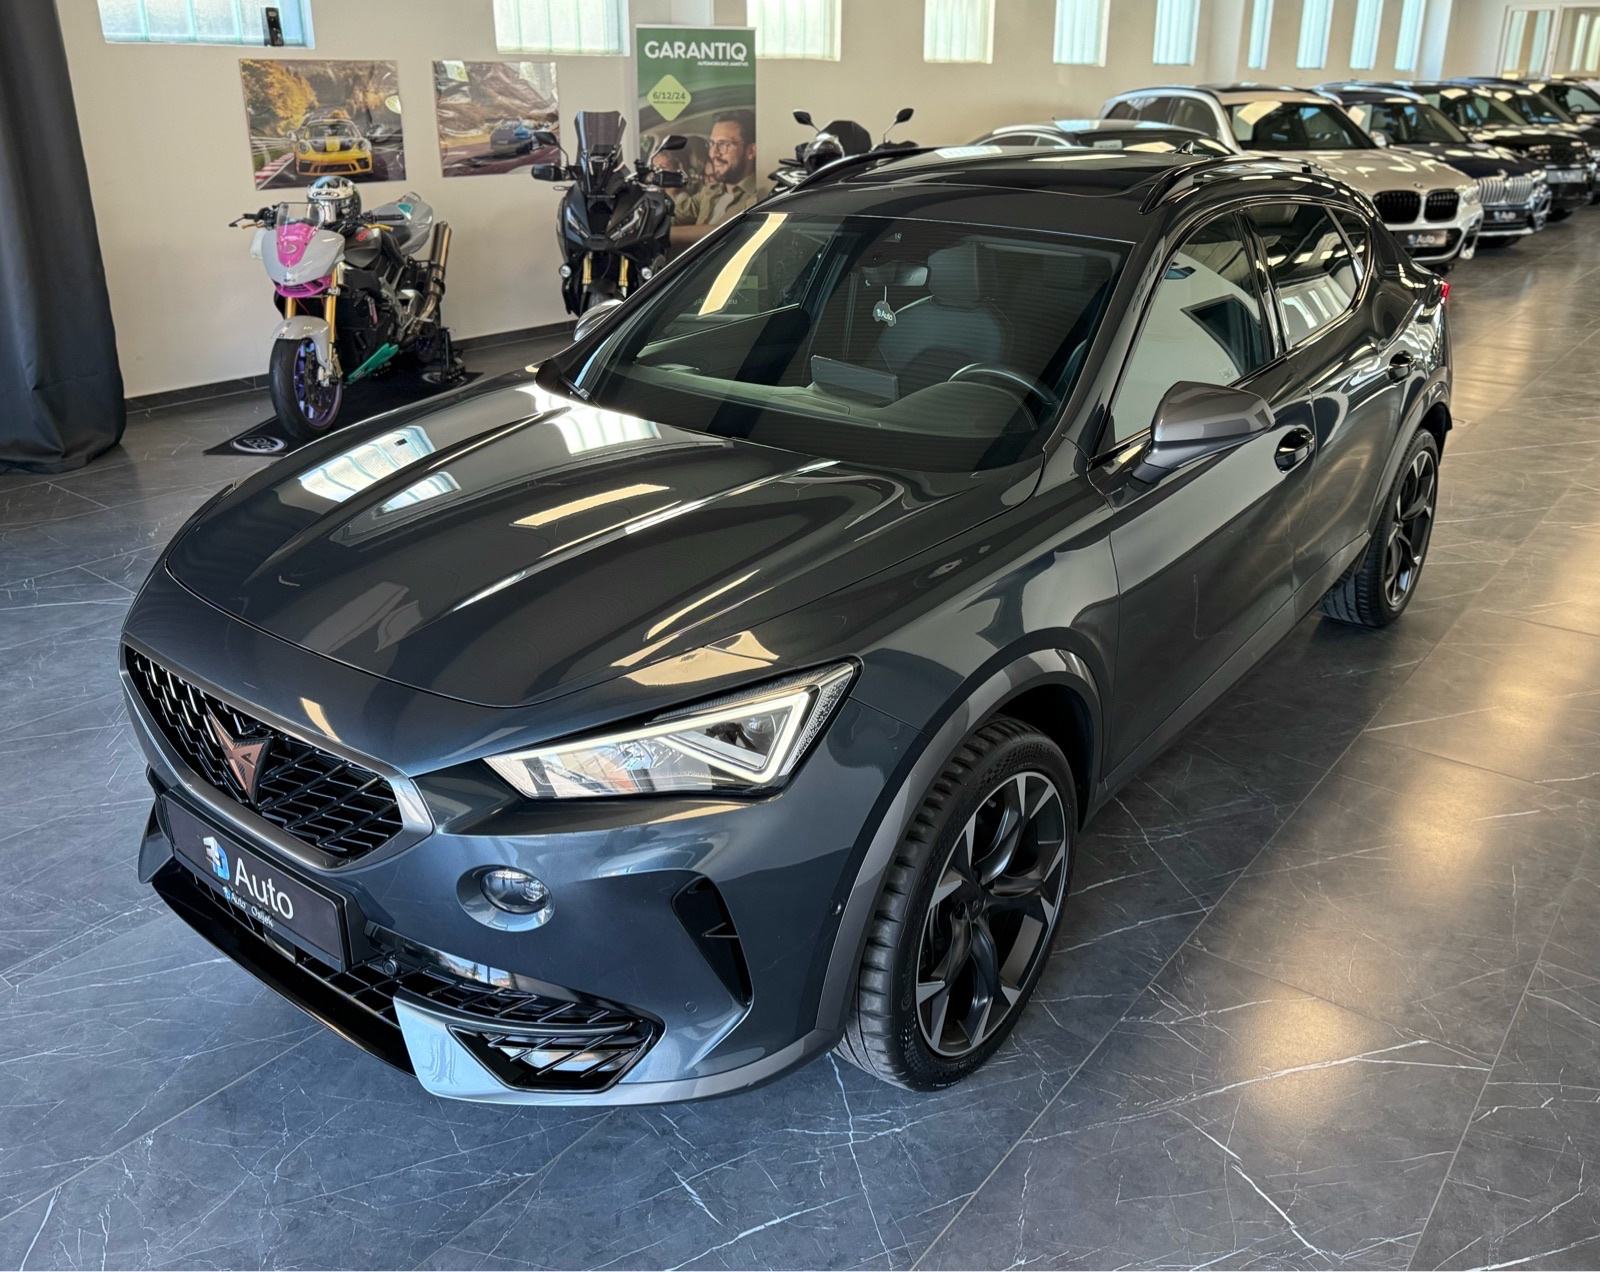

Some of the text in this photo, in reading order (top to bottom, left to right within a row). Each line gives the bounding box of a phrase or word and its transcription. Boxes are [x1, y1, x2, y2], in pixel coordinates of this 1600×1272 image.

[645, 41, 748, 61] GARANTIQ
[652, 91, 686, 100] 6/12/24
[1416, 235, 1436, 244] Auto
[235, 857, 294, 920] Auto
[230, 892, 247, 910] Auto
